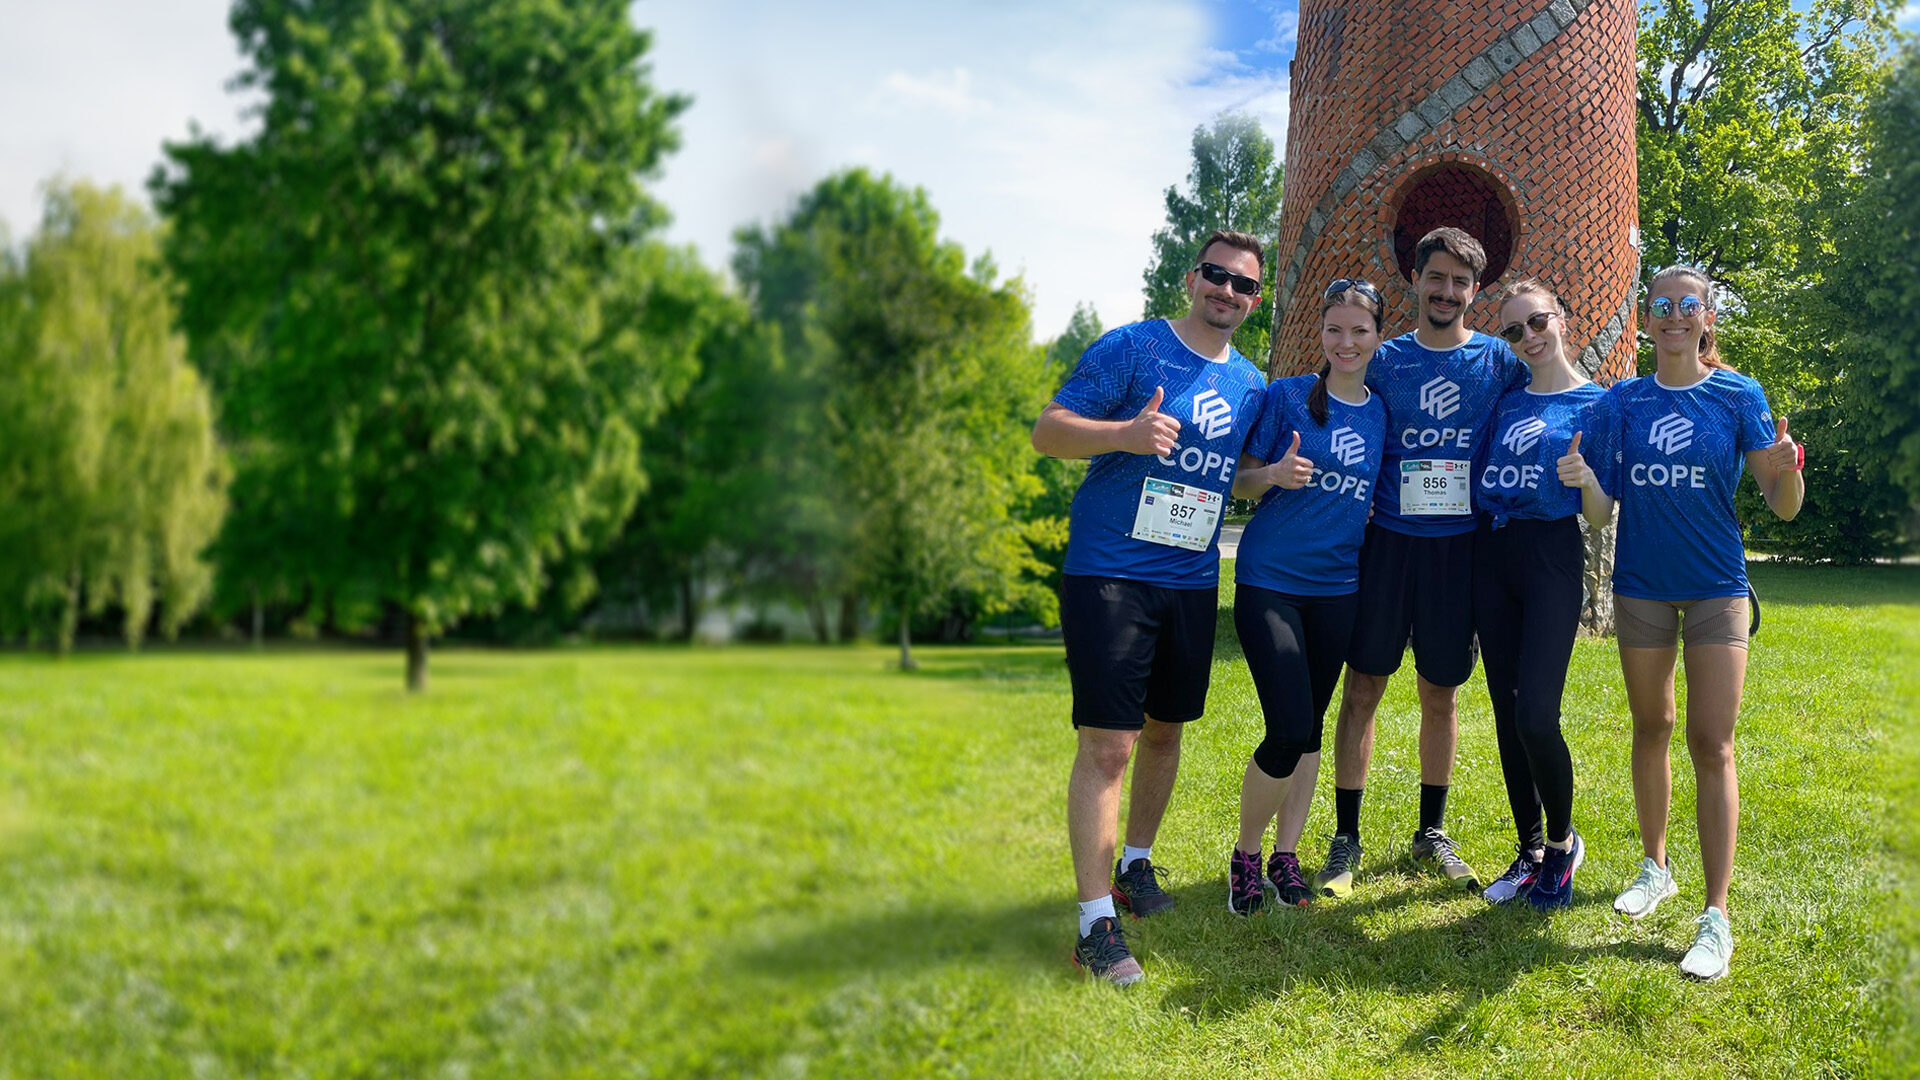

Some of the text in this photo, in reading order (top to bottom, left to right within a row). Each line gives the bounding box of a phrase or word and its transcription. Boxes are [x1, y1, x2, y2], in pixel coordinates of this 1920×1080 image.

[1401, 427, 1473, 449] COPE
[1304, 467, 1370, 501] COPE
[1423, 476, 1447, 489] 856
[1481, 464, 1544, 489] COPE
[1630, 463, 1706, 488] COPE
[1169, 517, 1193, 528] Michael
[1170, 503, 1197, 520] 857
